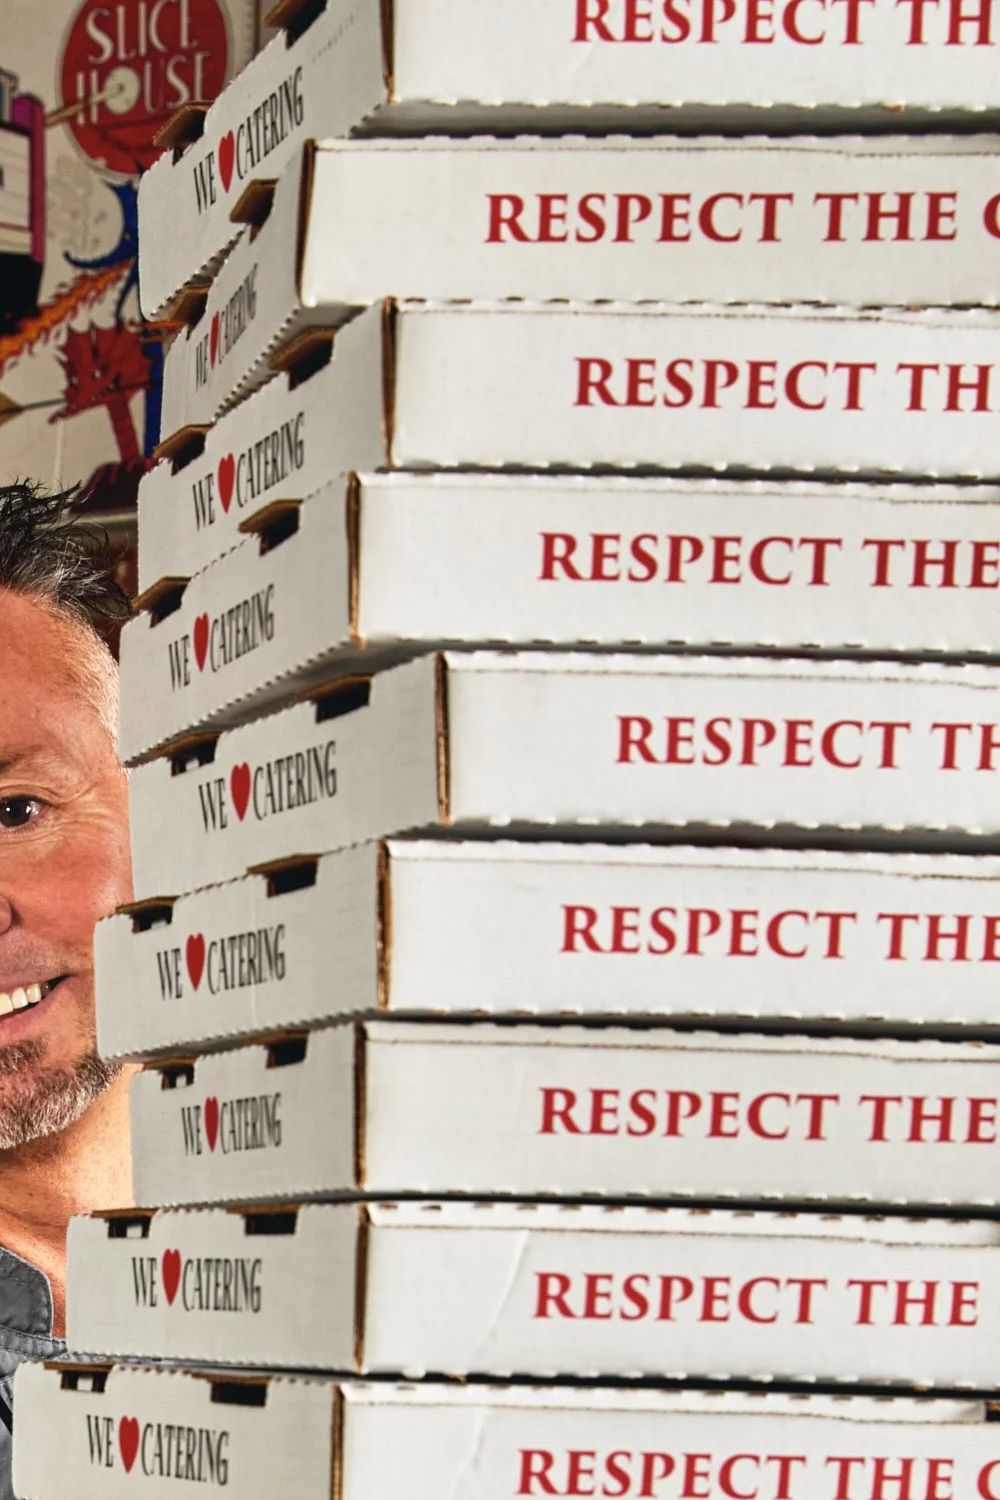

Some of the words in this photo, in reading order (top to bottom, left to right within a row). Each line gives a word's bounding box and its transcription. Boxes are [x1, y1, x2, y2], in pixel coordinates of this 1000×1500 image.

[85, 0, 198, 64] SLICE
[573, 0, 875, 46] RESPECT
[76, 51, 210, 127] HOUSE
[193, 151, 216, 216] WE
[236, 67, 303, 180] CATERING
[486, 192, 793, 243] RESPECT
[814, 192, 956, 242] THE
[196, 334, 209, 393] WE
[576, 358, 876, 410] RESPECT
[896, 363, 993, 412] TH
[192, 472, 216, 532] WE
[237, 412, 304, 508] CATERING
[537, 532, 842, 586] RESPECT
[862, 539, 1000, 589] THE
[168, 634, 190, 692] WE
[210, 584, 275, 673] CATERING
[615, 716, 911, 769] RESPECT
[198, 778, 227, 833] WE
[253, 740, 337, 820] CATERING
[560, 905, 857, 959] RESPECT
[156, 948, 182, 1000] WE
[207, 924, 285, 995] CATERING
[181, 1105, 202, 1156] WE
[220, 1092, 282, 1155] CATERING
[538, 1088, 839, 1141] RESPECT
[859, 1095, 998, 1144] THE
[132, 1257, 157, 1307] WE
[182, 1258, 262, 1313] CATERING
[534, 1272, 828, 1325] RESPECT
[846, 1279, 980, 1327] THE
[86, 1415, 114, 1468] WE
[141, 1423, 230, 1486] CATERING
[516, 1449, 806, 1500] RESPECT
